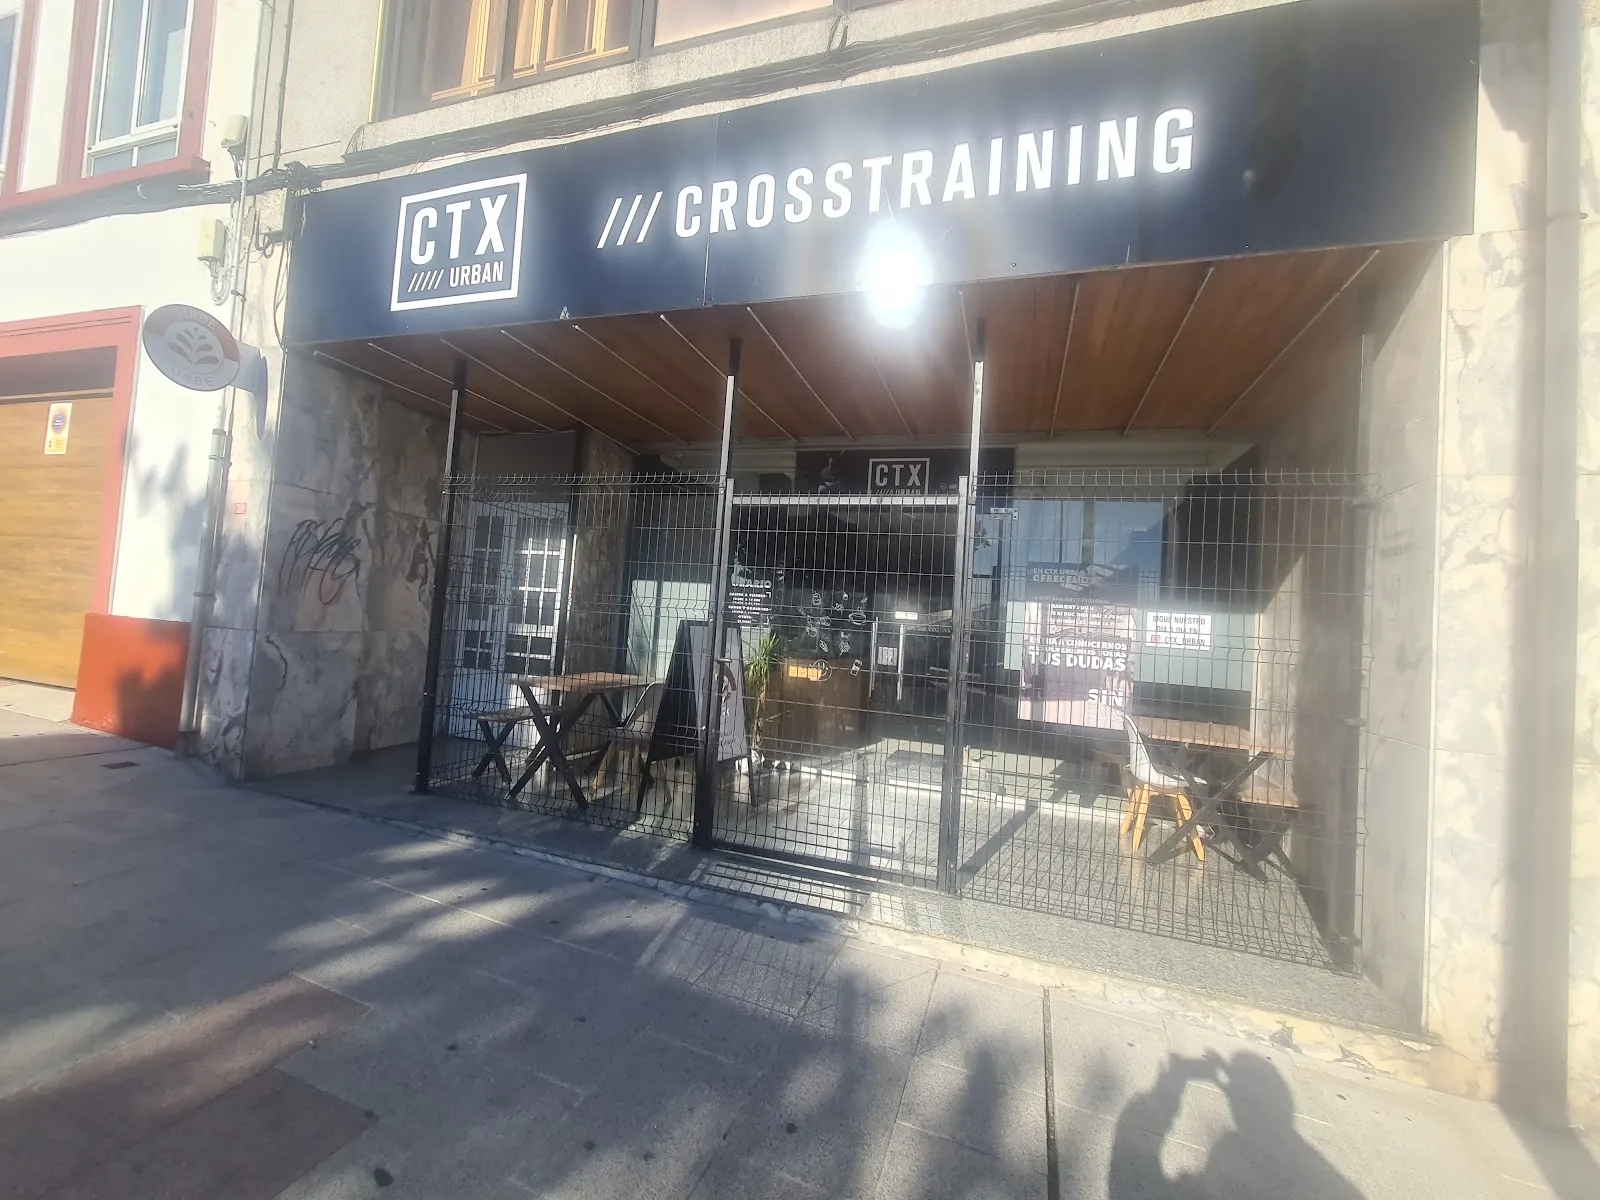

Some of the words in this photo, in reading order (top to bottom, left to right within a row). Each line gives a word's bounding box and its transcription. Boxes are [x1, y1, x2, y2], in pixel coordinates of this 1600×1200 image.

[675, 108, 1196, 239] CROSSTRAINING
[409, 193, 509, 265] CTX
[449, 260, 504, 288] URBAN
[875, 464, 922, 487] CTX
[1152, 615, 1172, 623] SIGUE
[1174, 617, 1206, 625] NUESTRO
[1029, 636, 1057, 646] ENRA
[1028, 650, 1061, 667] TUS
[1065, 653, 1127, 672] DUDAS
[1087, 688, 1124, 708] SIN
